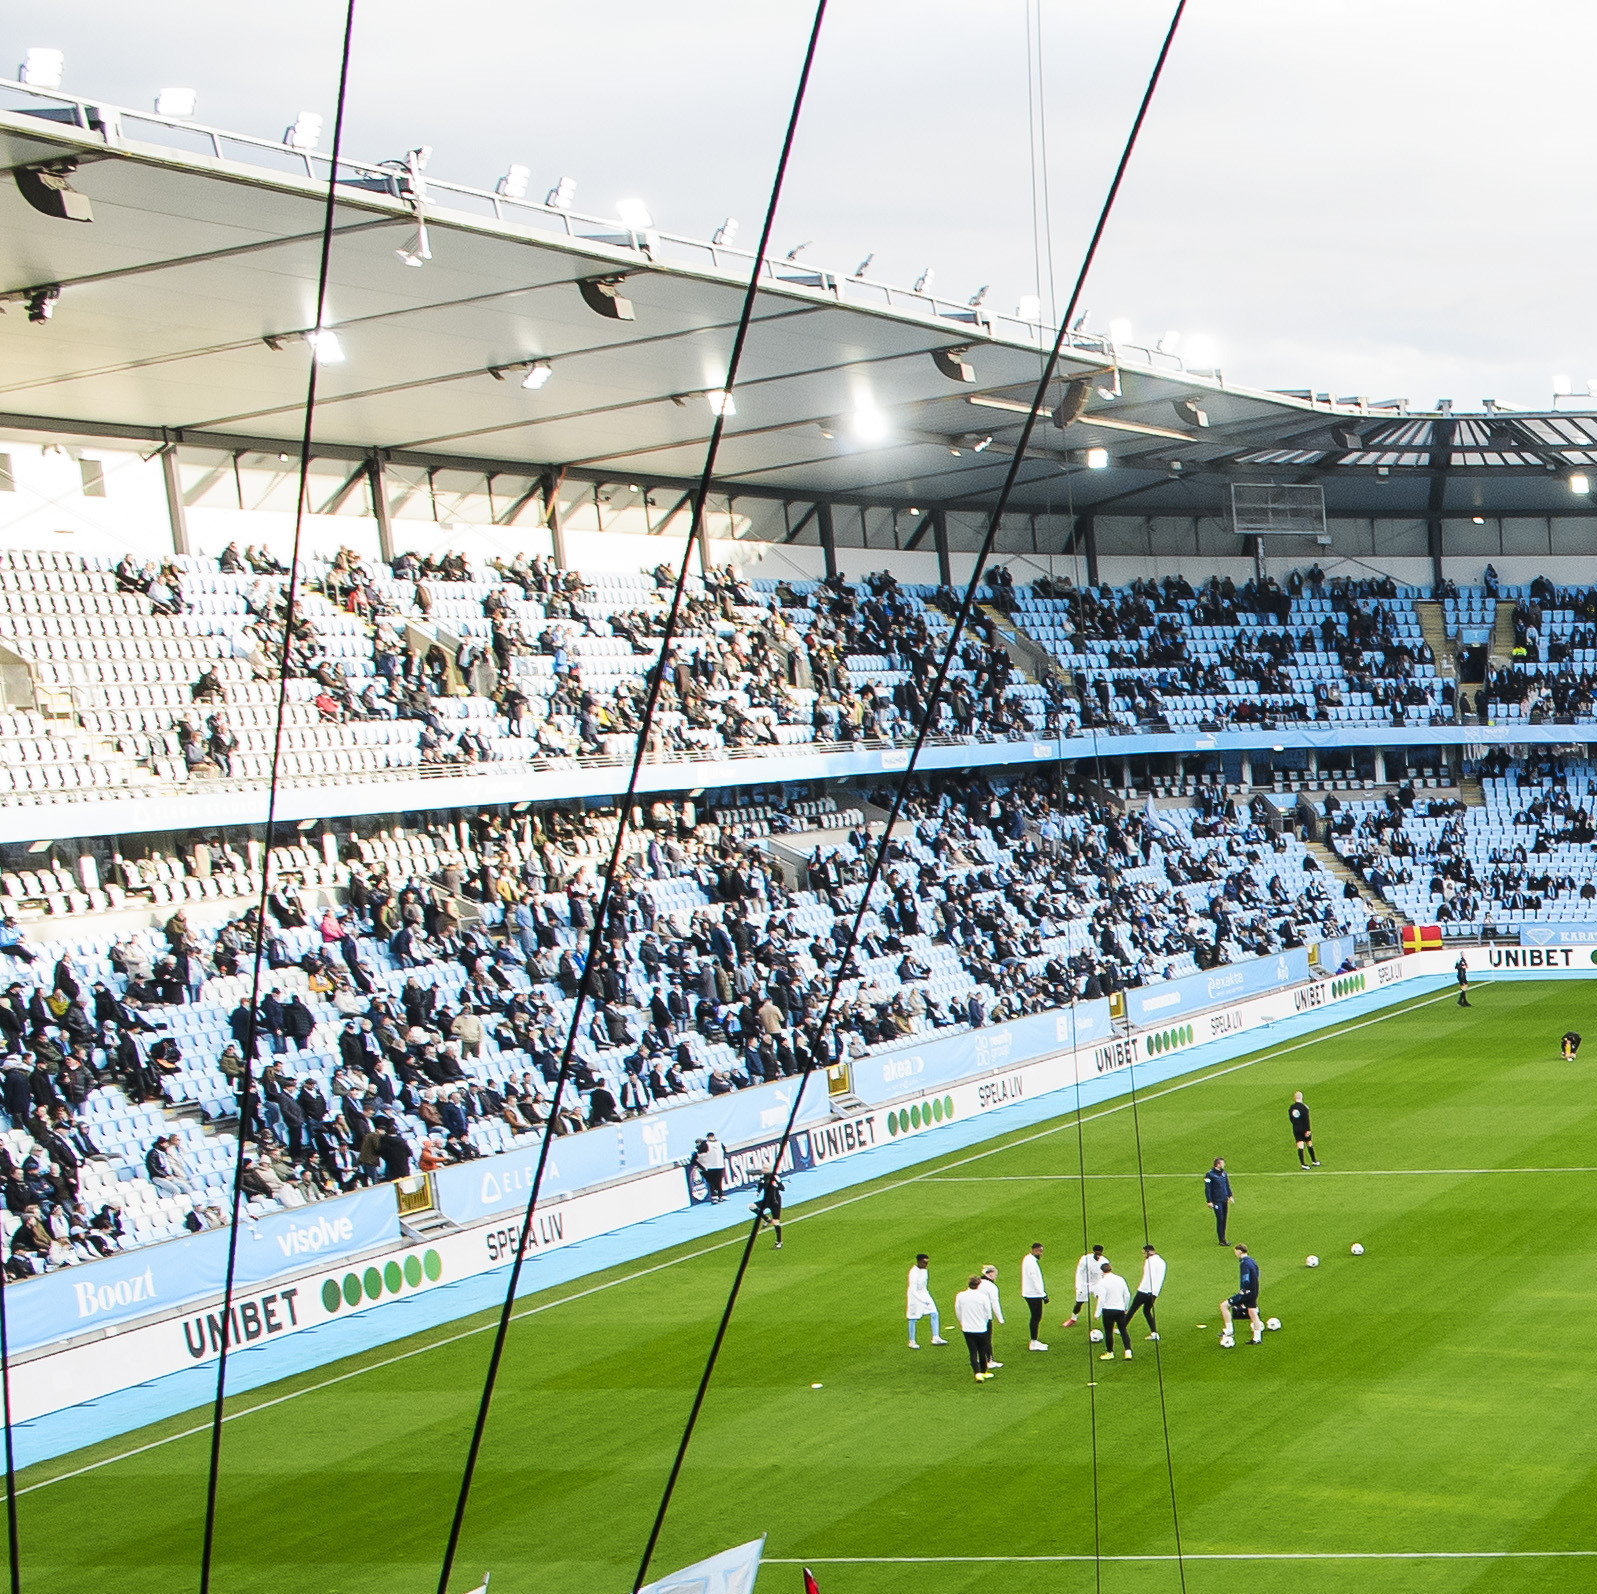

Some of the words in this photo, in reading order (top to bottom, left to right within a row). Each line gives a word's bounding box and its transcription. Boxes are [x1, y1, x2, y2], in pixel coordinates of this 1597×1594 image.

[1489, 948, 1574, 968] UNIBET
[1294, 983, 1326, 1011] UNIBET
[882, 1057, 912, 1083] akea
[1095, 1038, 1139, 1072] UNIBET
[812, 1115, 876, 1160] UNIBET
[978, 1079, 1008, 1107] SPELA
[1010, 1074, 1024, 1098] LIV
[277, 1216, 353, 1257] visolve
[73, 1264, 157, 1318] Boozt
[183, 1288, 299, 1359] UNIBET
[540, 1212, 564, 1244] LIV
